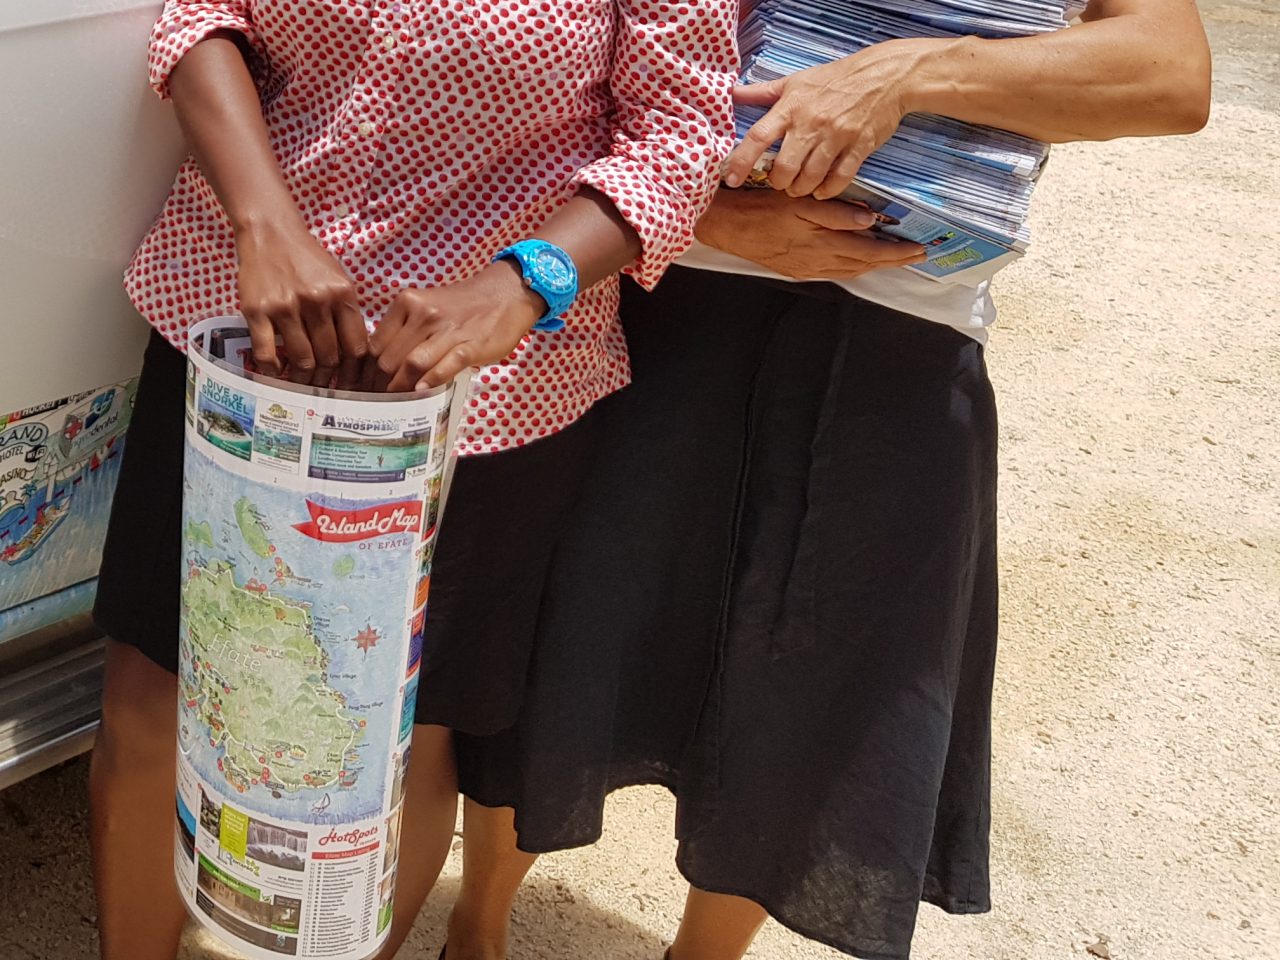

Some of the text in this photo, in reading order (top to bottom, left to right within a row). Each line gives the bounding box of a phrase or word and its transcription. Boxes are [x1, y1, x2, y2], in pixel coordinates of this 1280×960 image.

[207, 377, 230, 397] DIVE
[201, 384, 250, 415] SNORKEL
[0, 446, 24, 463] HOTEL
[317, 507, 419, 535] Island Map
[359, 537, 409, 551] OF EFATE
[318, 825, 379, 847] HotSpots
